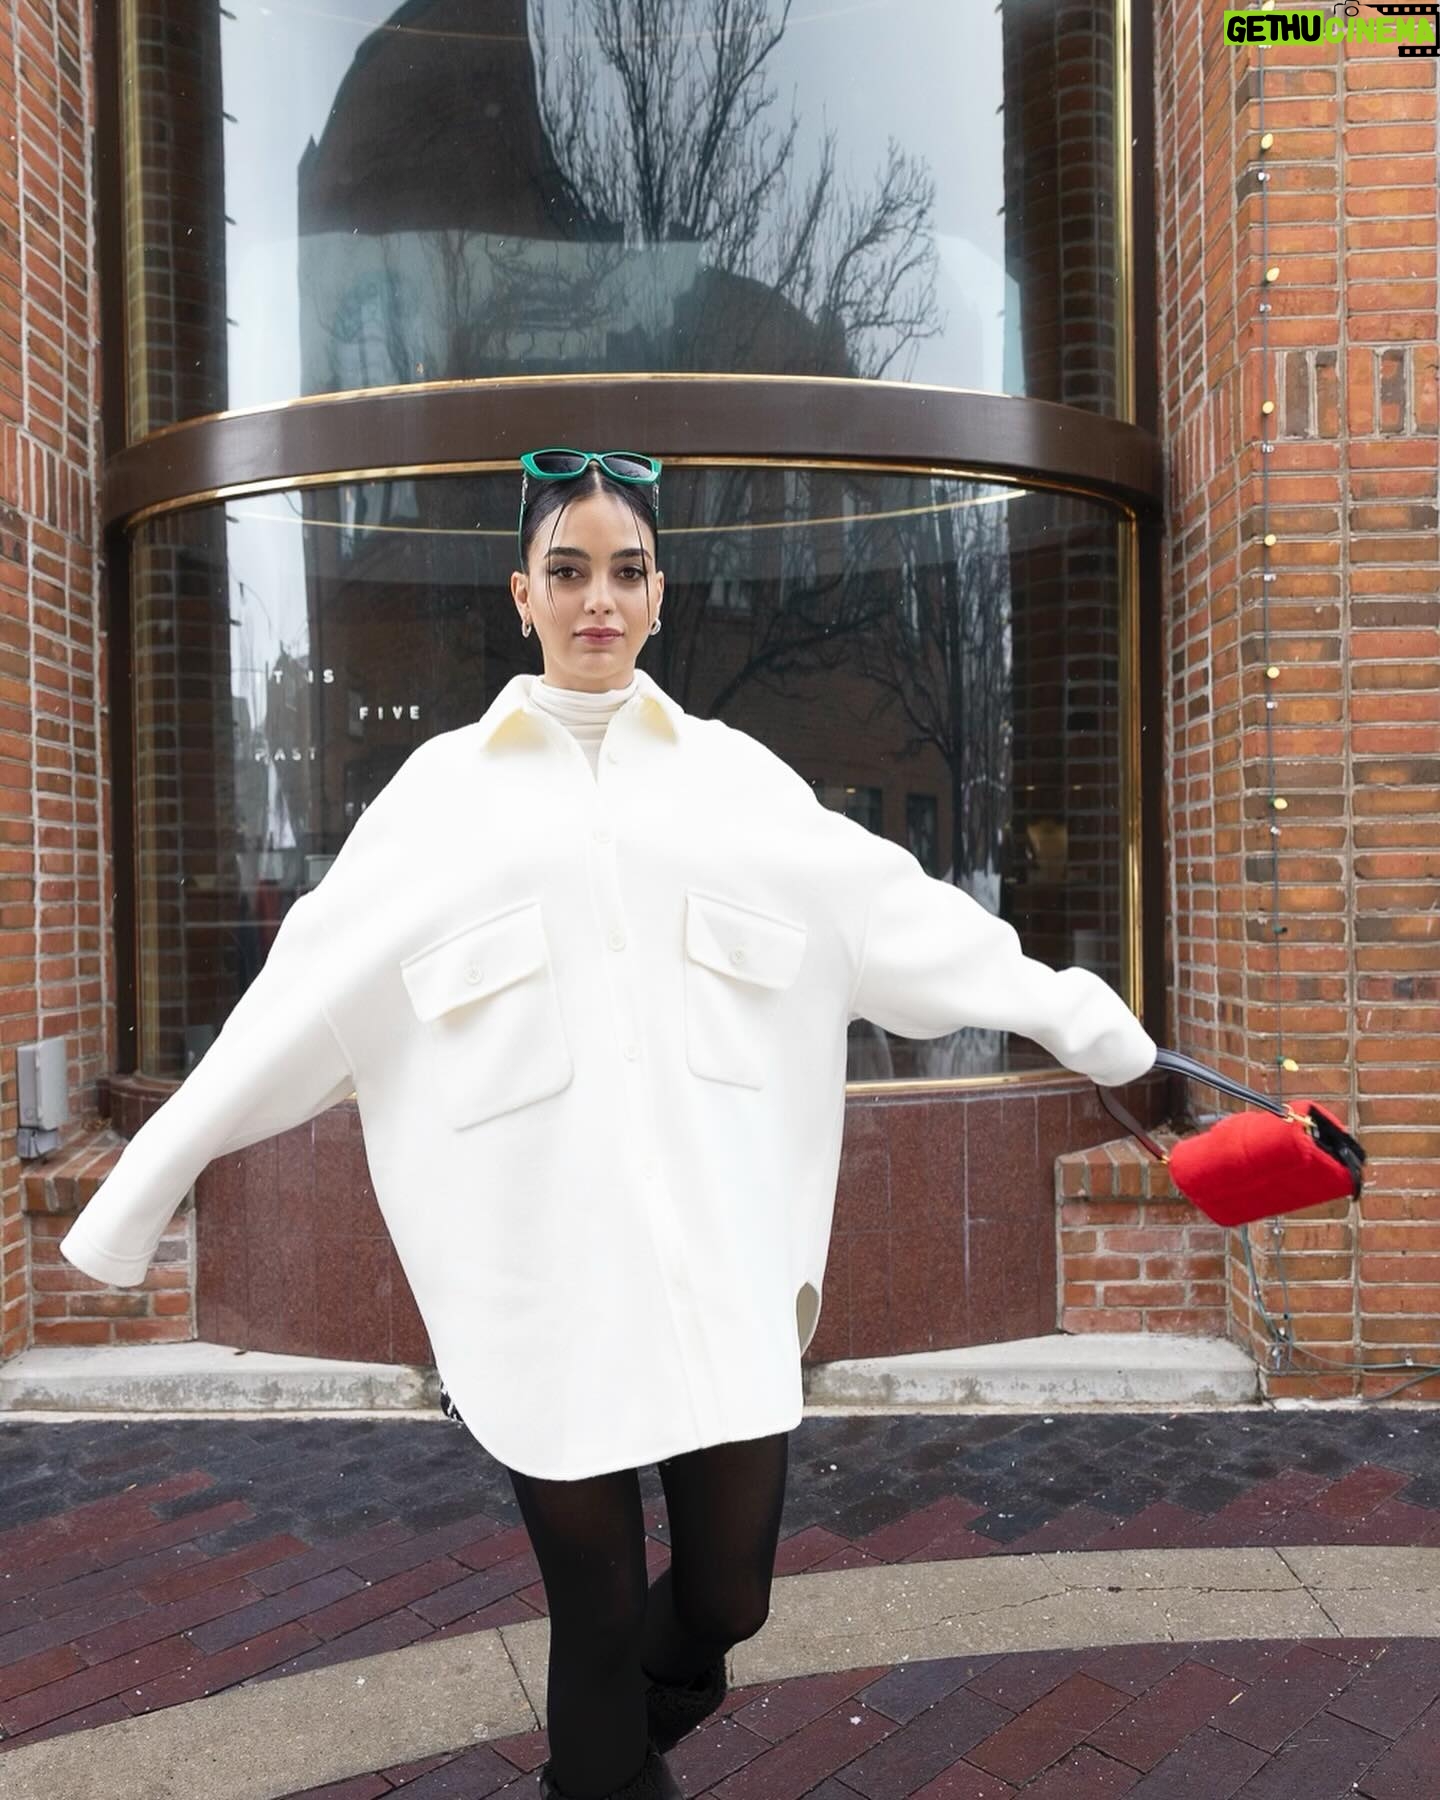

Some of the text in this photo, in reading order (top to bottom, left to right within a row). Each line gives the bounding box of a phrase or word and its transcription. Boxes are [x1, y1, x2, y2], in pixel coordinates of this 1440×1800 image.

[307, 669, 335, 684] IS
[359, 705, 420, 720] FIVE
[255, 747, 316, 762] PAST
